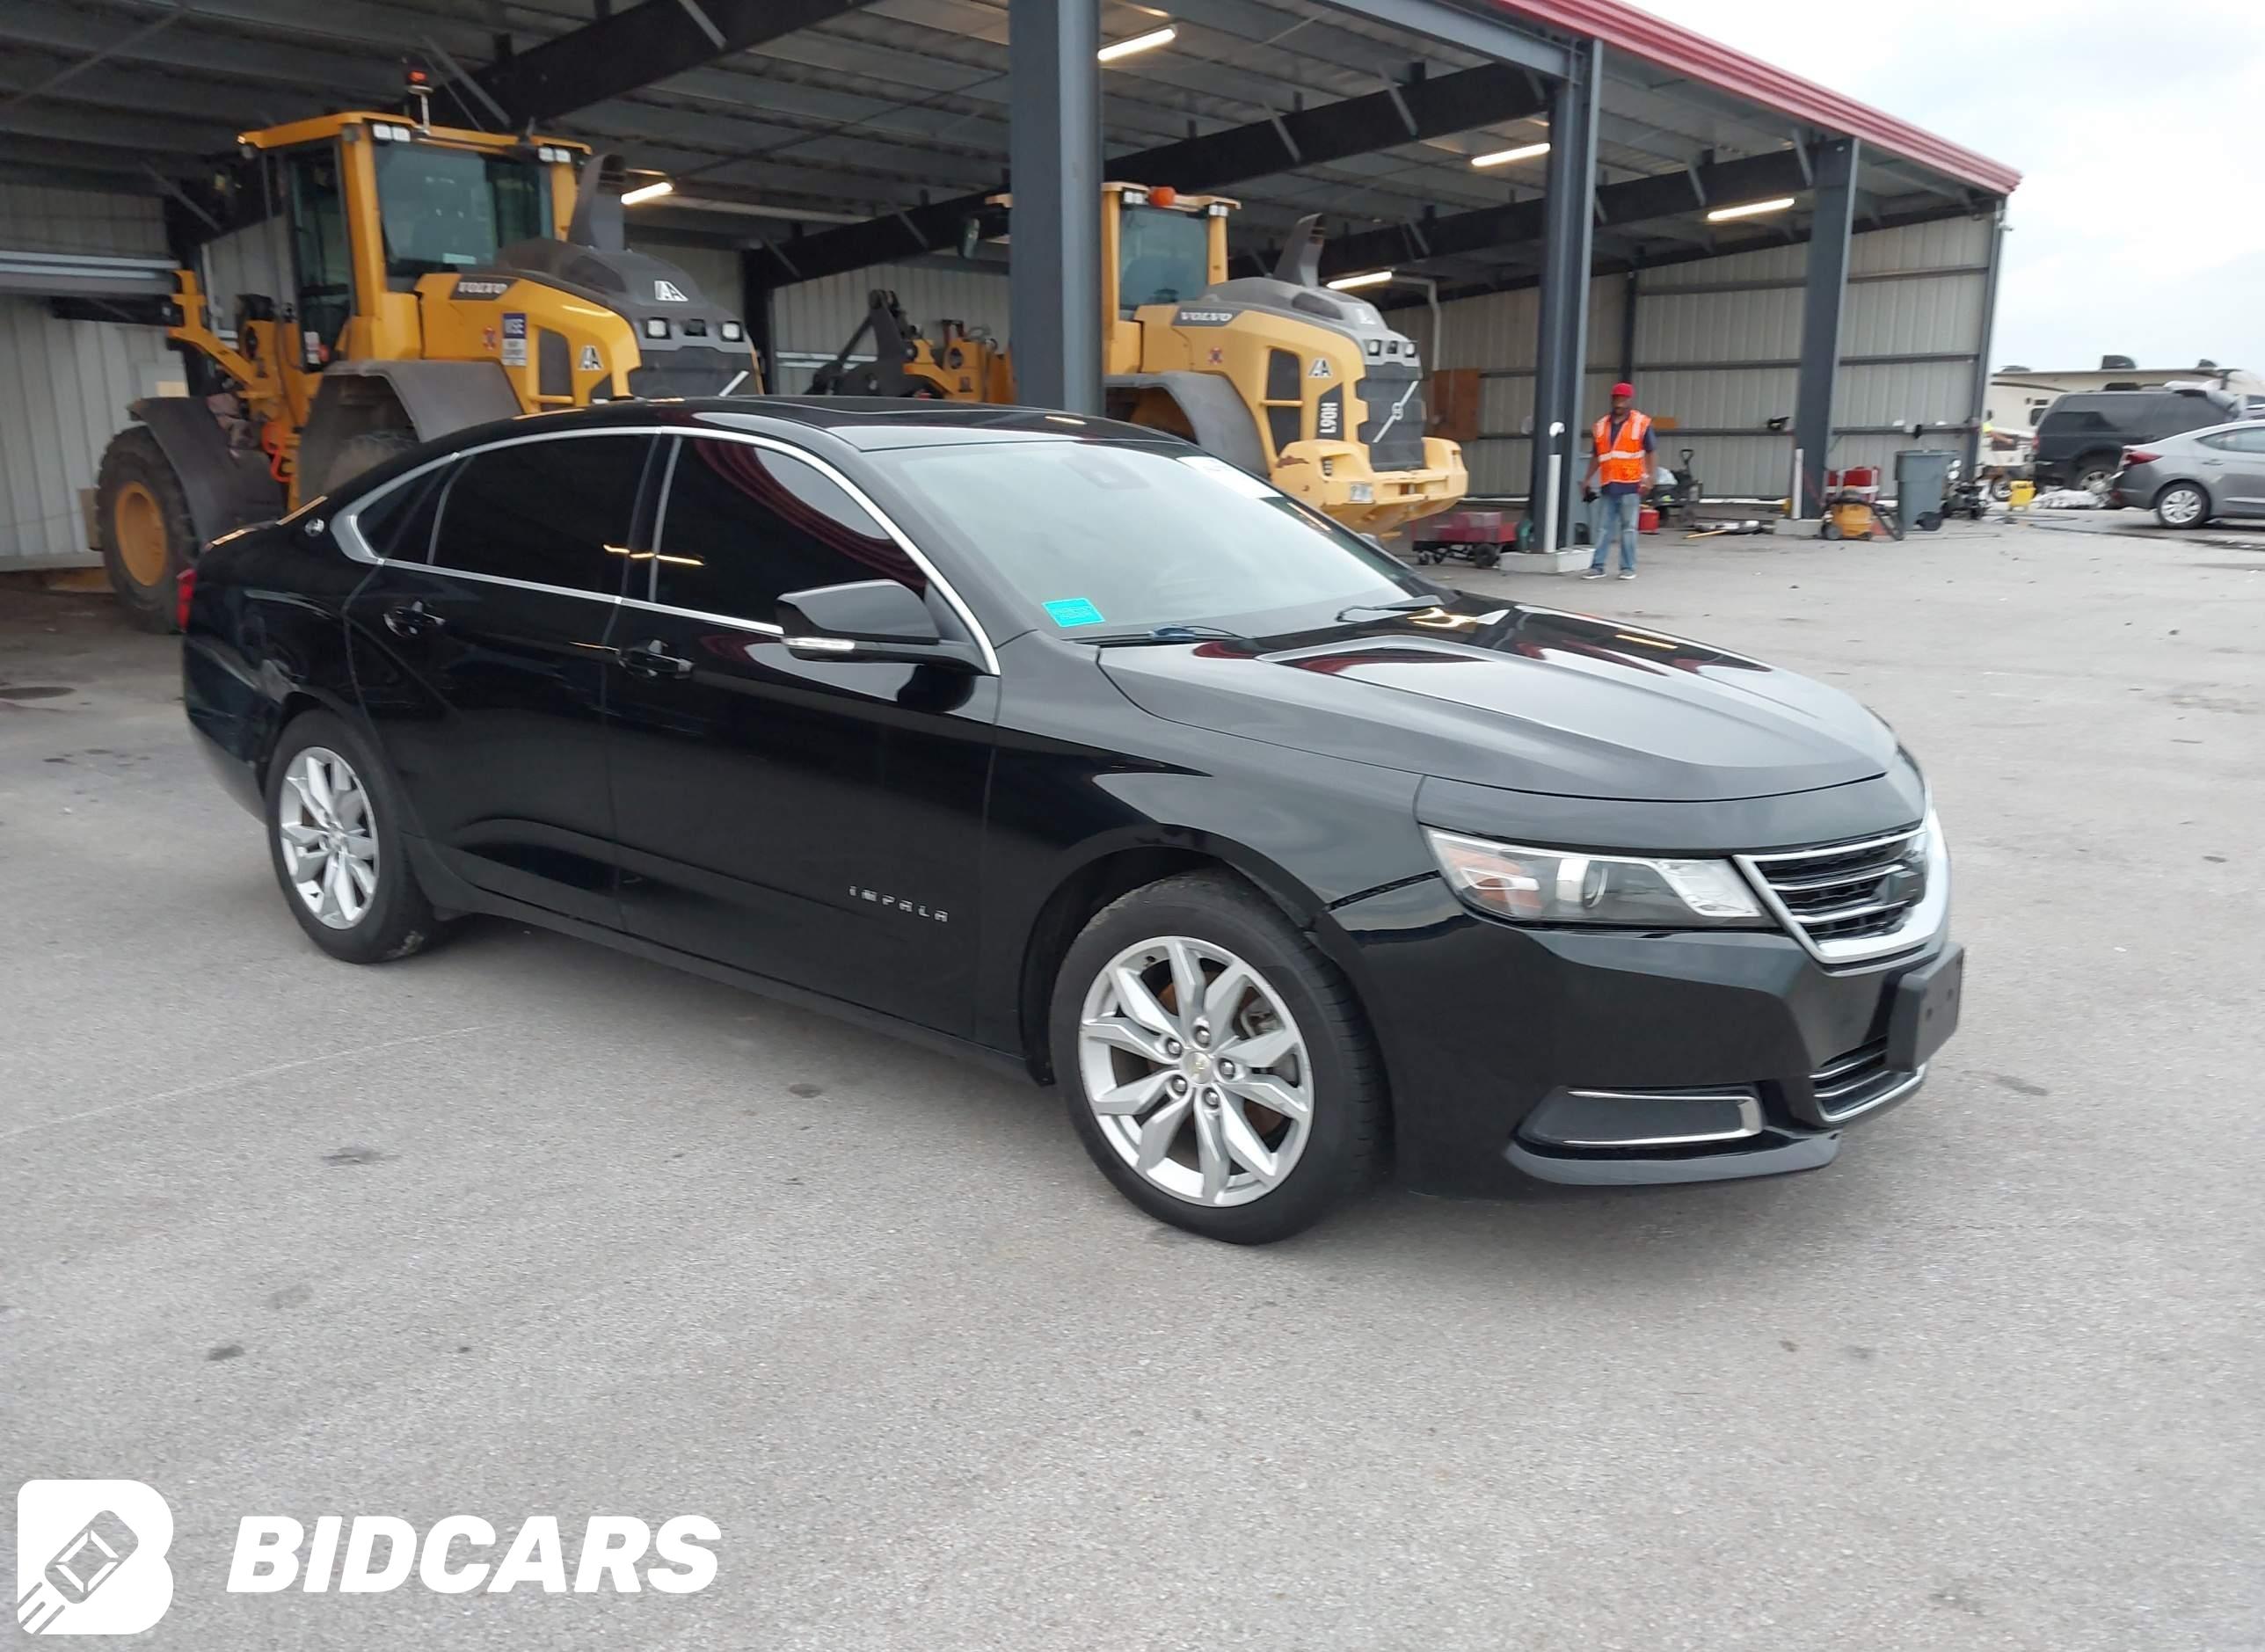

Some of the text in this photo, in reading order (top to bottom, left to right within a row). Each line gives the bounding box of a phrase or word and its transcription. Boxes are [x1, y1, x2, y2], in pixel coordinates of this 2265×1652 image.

[1181, 311, 1233, 322] VOLVO
[1319, 402, 1339, 433] L90H
[848, 885, 949, 922] IMPALA
